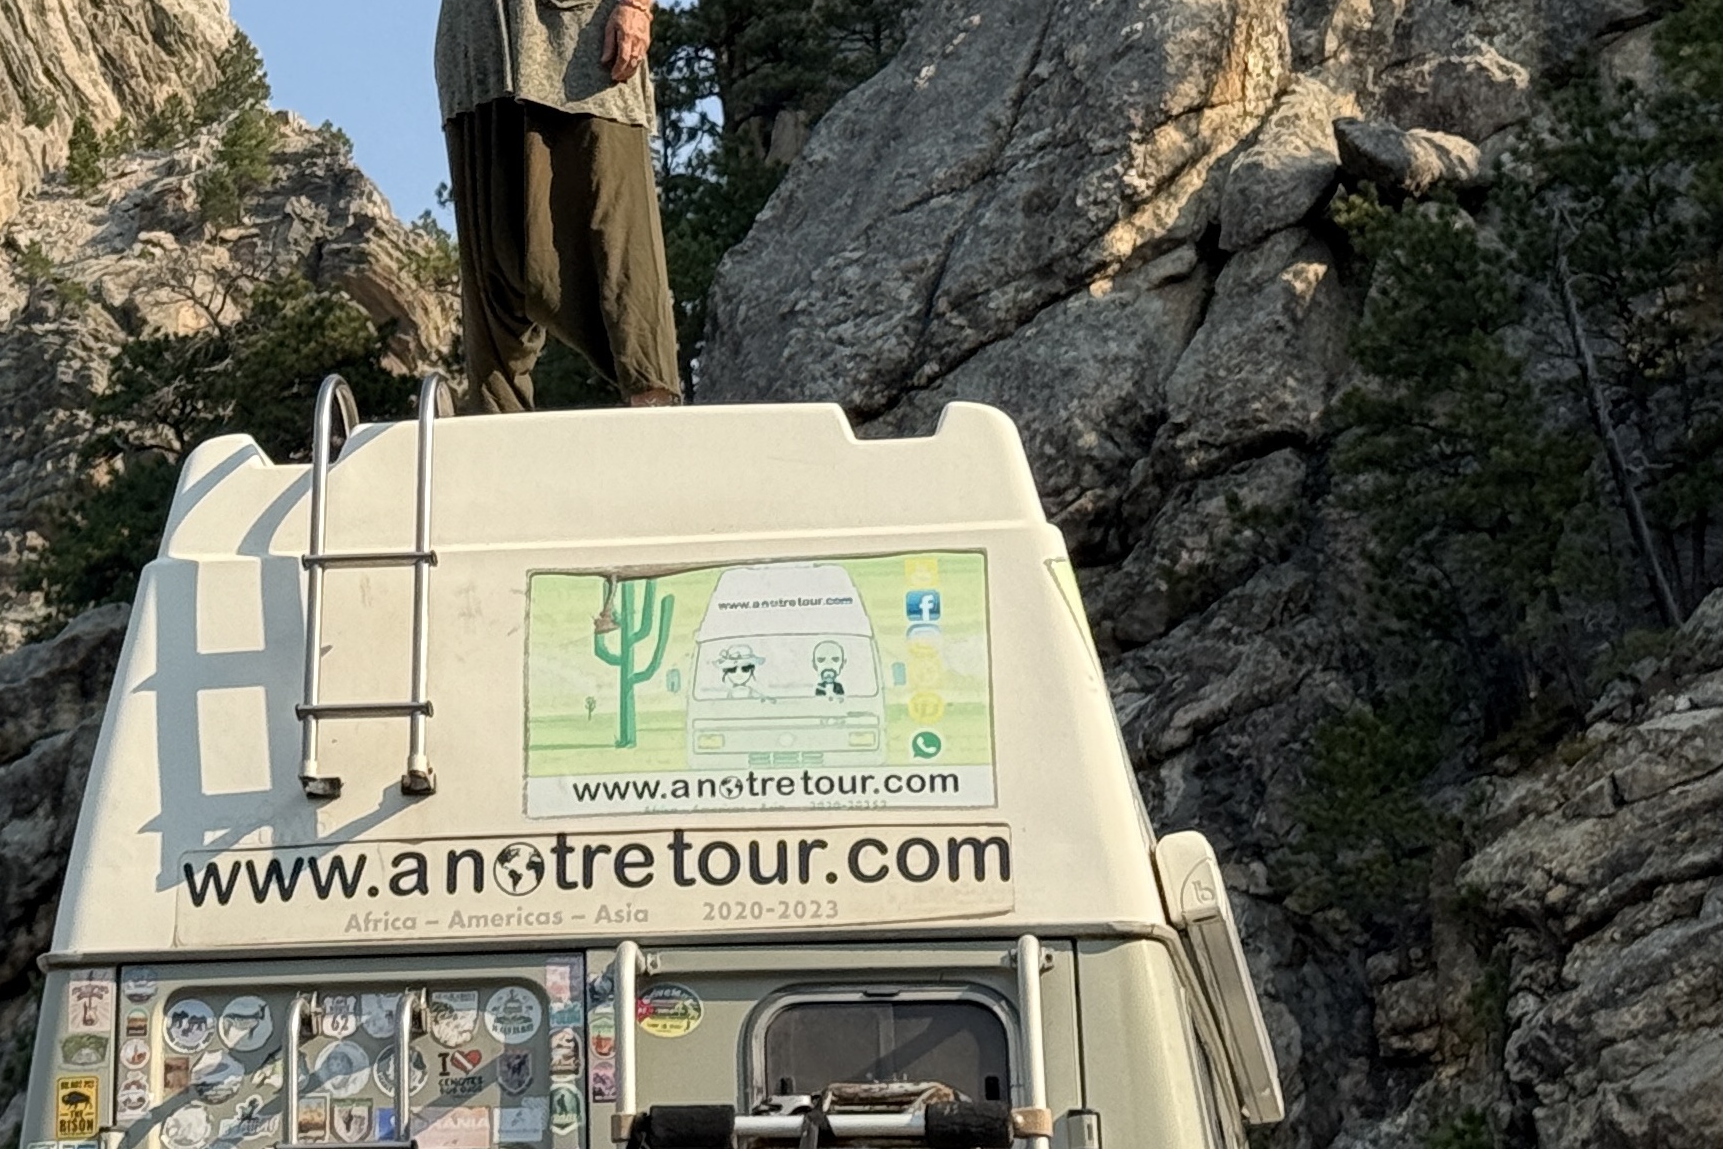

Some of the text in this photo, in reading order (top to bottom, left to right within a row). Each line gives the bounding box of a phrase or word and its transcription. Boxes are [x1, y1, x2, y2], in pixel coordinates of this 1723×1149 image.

[344, 912, 417, 933] Africa
[447, 906, 563, 930] Americas
[594, 903, 649, 925] Asia
[702, 900, 839, 922] 2020-2023
[437, 1052, 451, 1076] I
[59, 1118, 94, 1133] BISON
